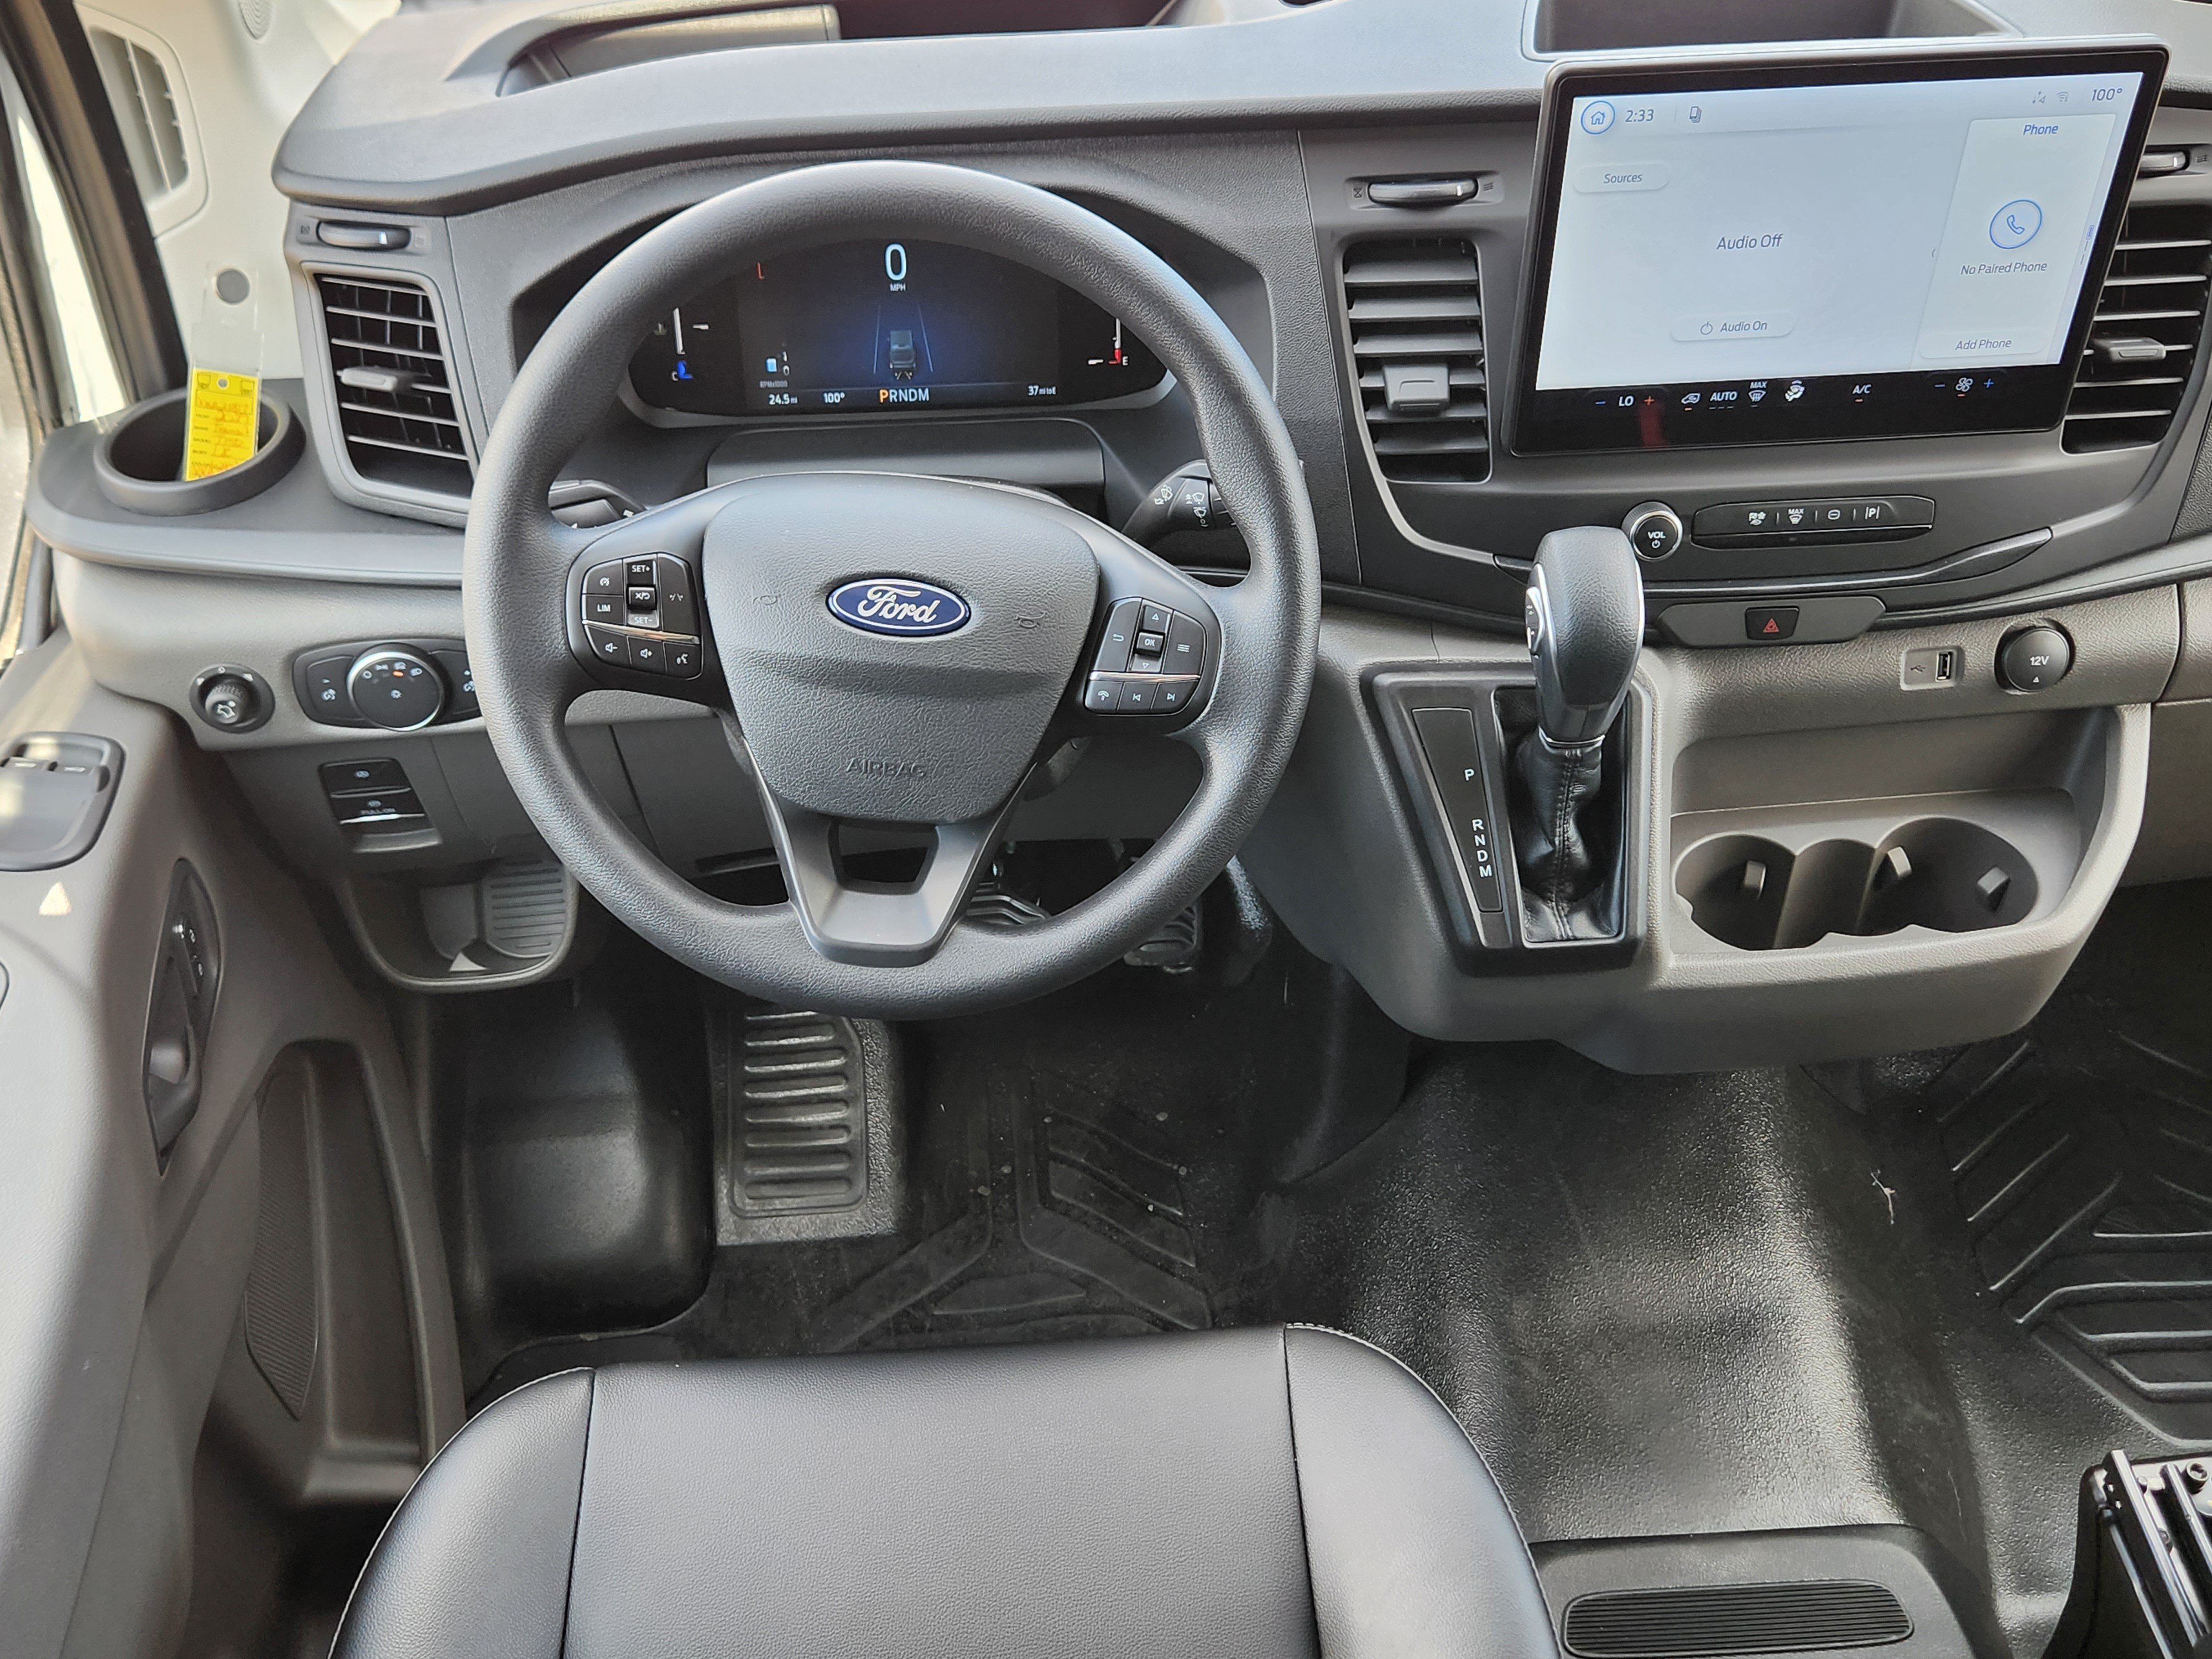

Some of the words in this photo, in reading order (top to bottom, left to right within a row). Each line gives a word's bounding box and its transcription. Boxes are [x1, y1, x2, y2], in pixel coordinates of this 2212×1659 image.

[2091, 87, 2123, 102] 100°
[1625, 108, 1655, 123] 2:33
[2022, 124, 2059, 135] Phone
[1603, 173, 1643, 184] Sources
[1716, 235, 1757, 250] Audio
[1760, 233, 1783, 248] Off
[885, 242, 907, 281] 0
[1960, 264, 1976, 275] No
[1978, 262, 2012, 274] Paired
[2013, 261, 2048, 273] Phone
[889, 283, 906, 292] MPH
[1719, 321, 1751, 333] Audio
[1752, 320, 1768, 331] On
[1955, 339, 1978, 351] Add
[1978, 338, 2012, 349] Phone
[1122, 356, 1129, 366] E
[1750, 380, 1768, 389] MAX
[1852, 384, 1872, 394] A/C
[1027, 385, 1039, 397] 37
[1709, 391, 1738, 402] AUTO
[769, 394, 790, 405] 24.5
[823, 392, 846, 404] 100°
[1618, 395, 1634, 406] LO
[1647, 530, 1666, 540] VOL
[597, 604, 611, 612] LIM
[858, 585, 941, 623] Ford
[1144, 638, 1155, 646] OK
[2030, 655, 2049, 666] 12V
[847, 758, 925, 777] AIRBAG
[1464, 768, 1475, 781] P
[1472, 818, 1484, 831] R
[1474, 834, 1486, 847] N
[1477, 849, 1488, 862] D
[1479, 865, 1493, 878] M
